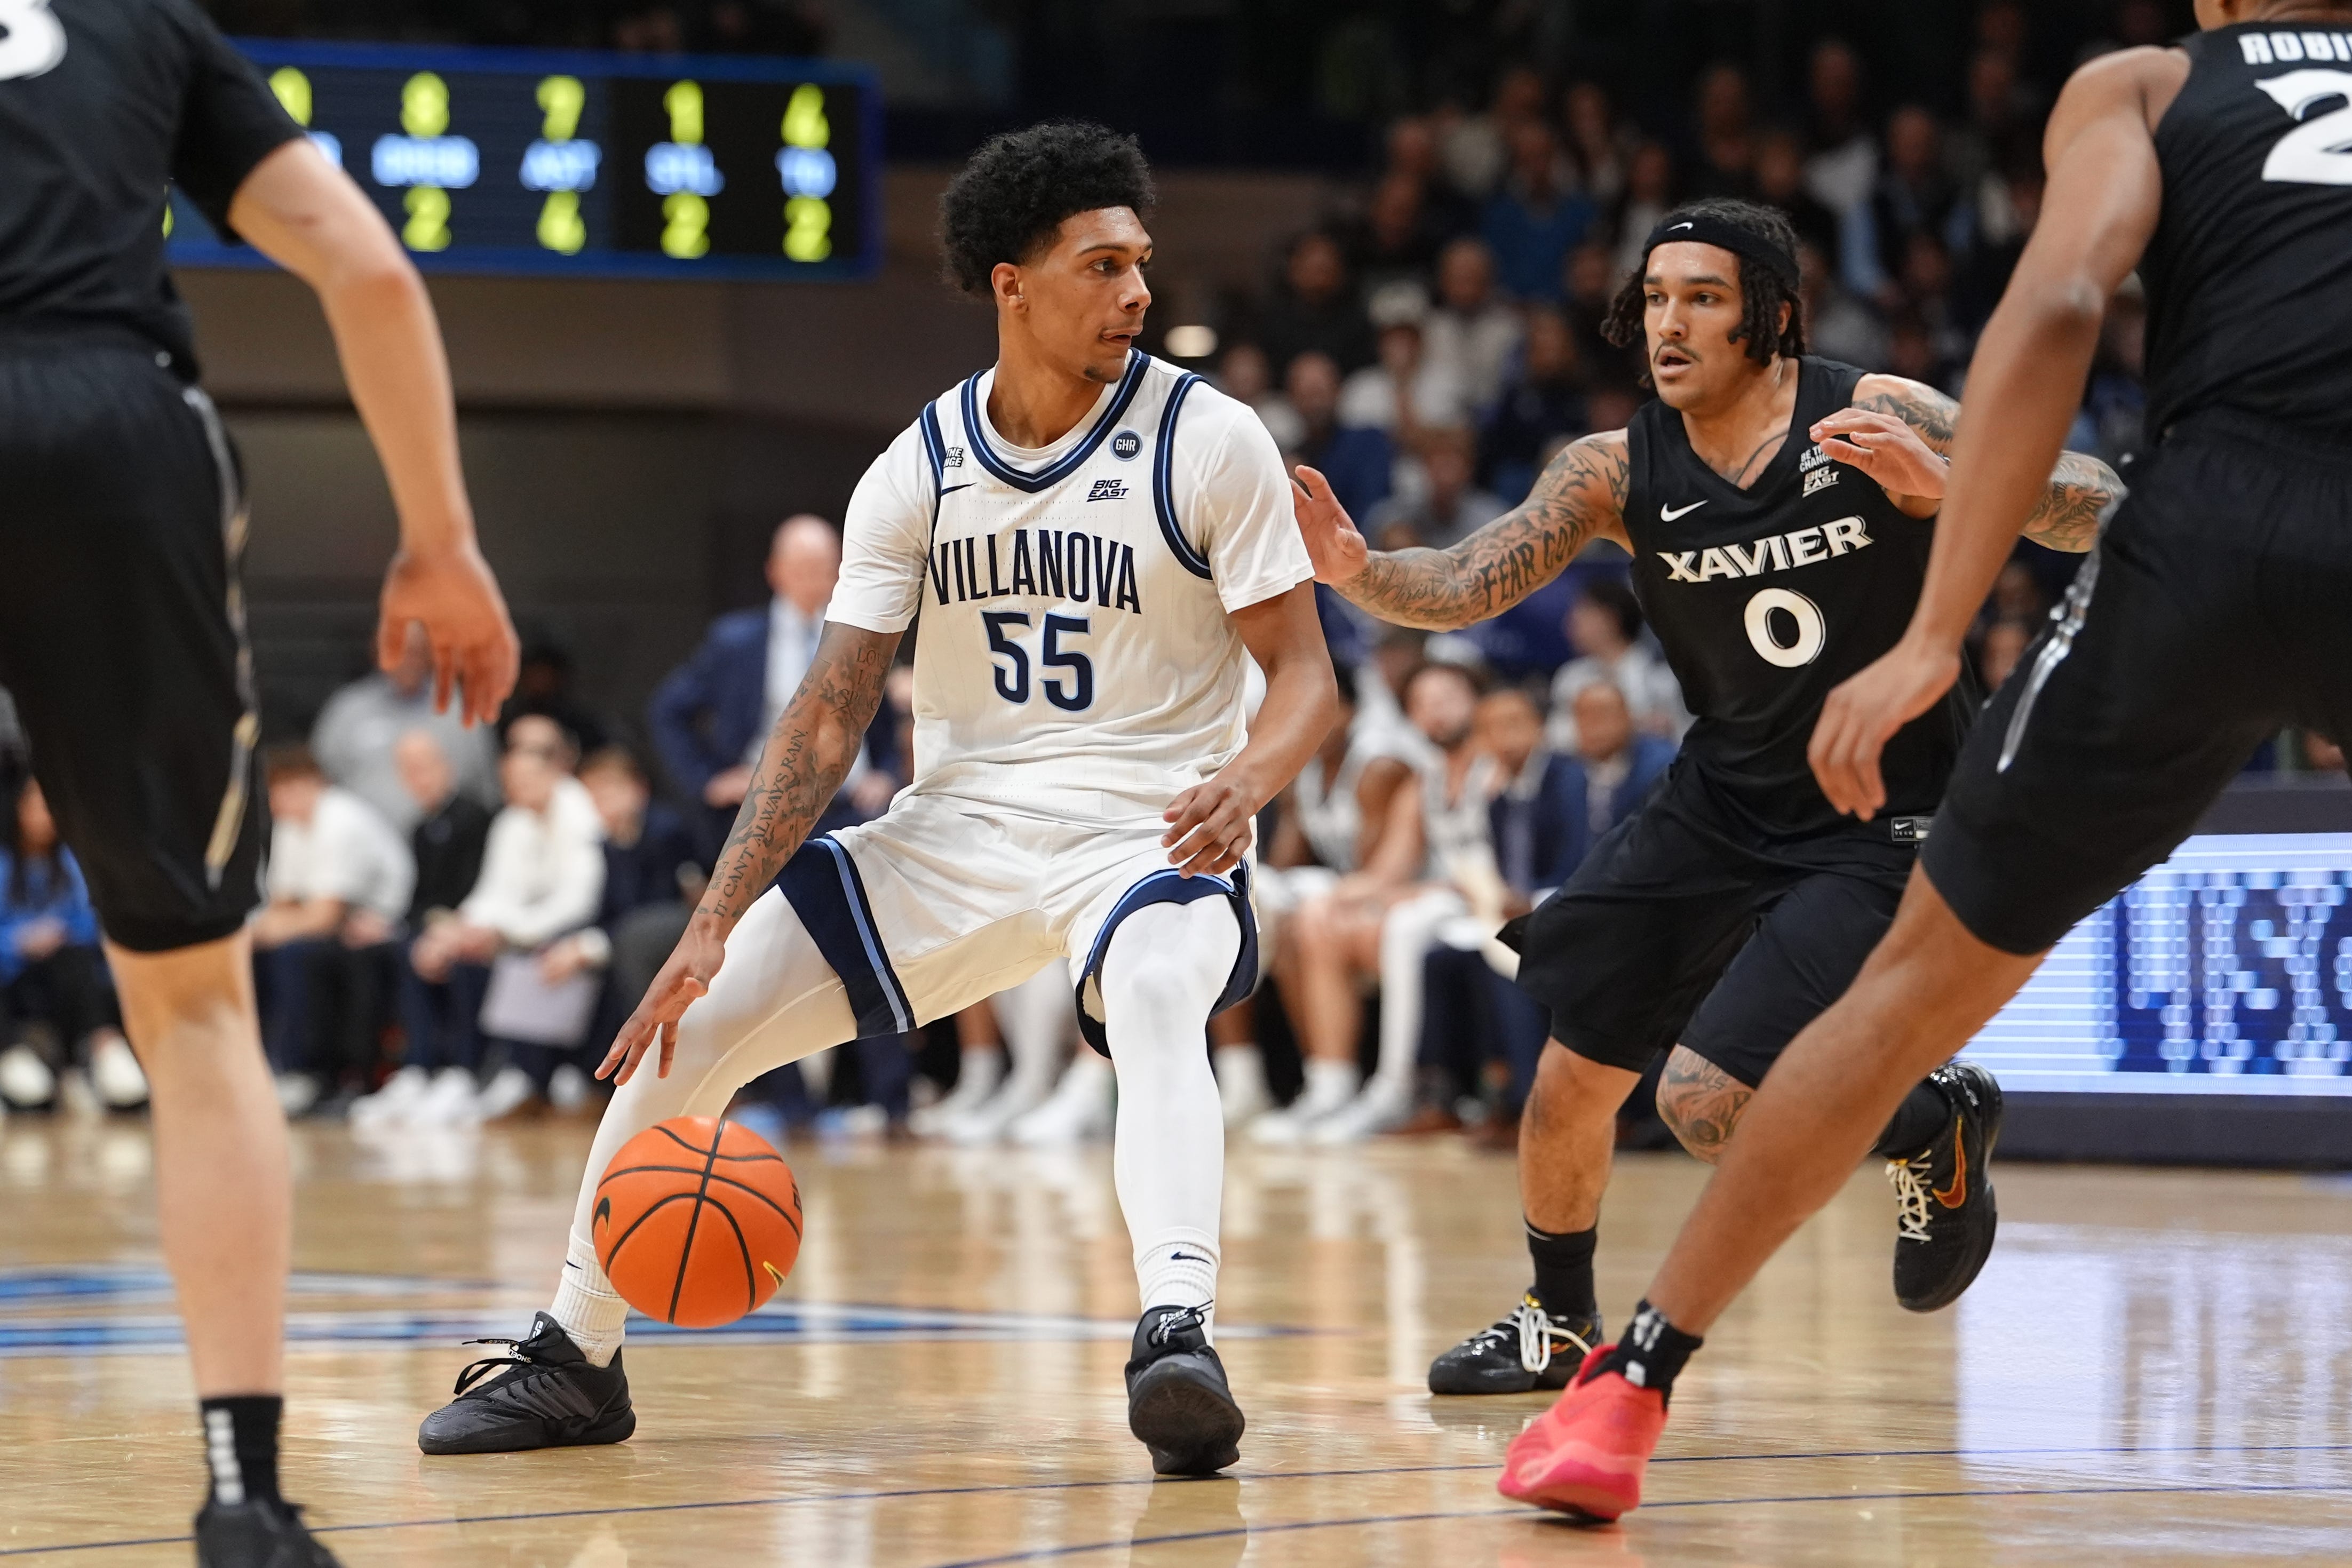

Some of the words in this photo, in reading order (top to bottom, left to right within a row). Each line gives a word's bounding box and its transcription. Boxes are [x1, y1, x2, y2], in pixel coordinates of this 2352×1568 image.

[2238, 31, 2352, 65] ROBI
[536, 75, 585, 143] 7
[663, 79, 704, 143] 1
[2253, 68, 2352, 185] 2
[401, 186, 451, 252] 2
[660, 192, 710, 259] 2
[783, 196, 832, 262] 2
[1116, 439, 1136, 451] GHR
[1805, 466, 1830, 483] BIG
[1088, 488, 1129, 498] EAST
[1093, 479, 1122, 489] BIG
[1803, 471, 1839, 492] EAST
[929, 529, 1142, 614] VILLANOVA
[1479, 542, 1537, 612] FEAR
[1657, 515, 1874, 583] XAVIER
[980, 609, 1095, 713] 55
[1744, 587, 1826, 668] 0
[713, 900, 728, 919] IT
[752, 773, 789, 847] ALWAYS
